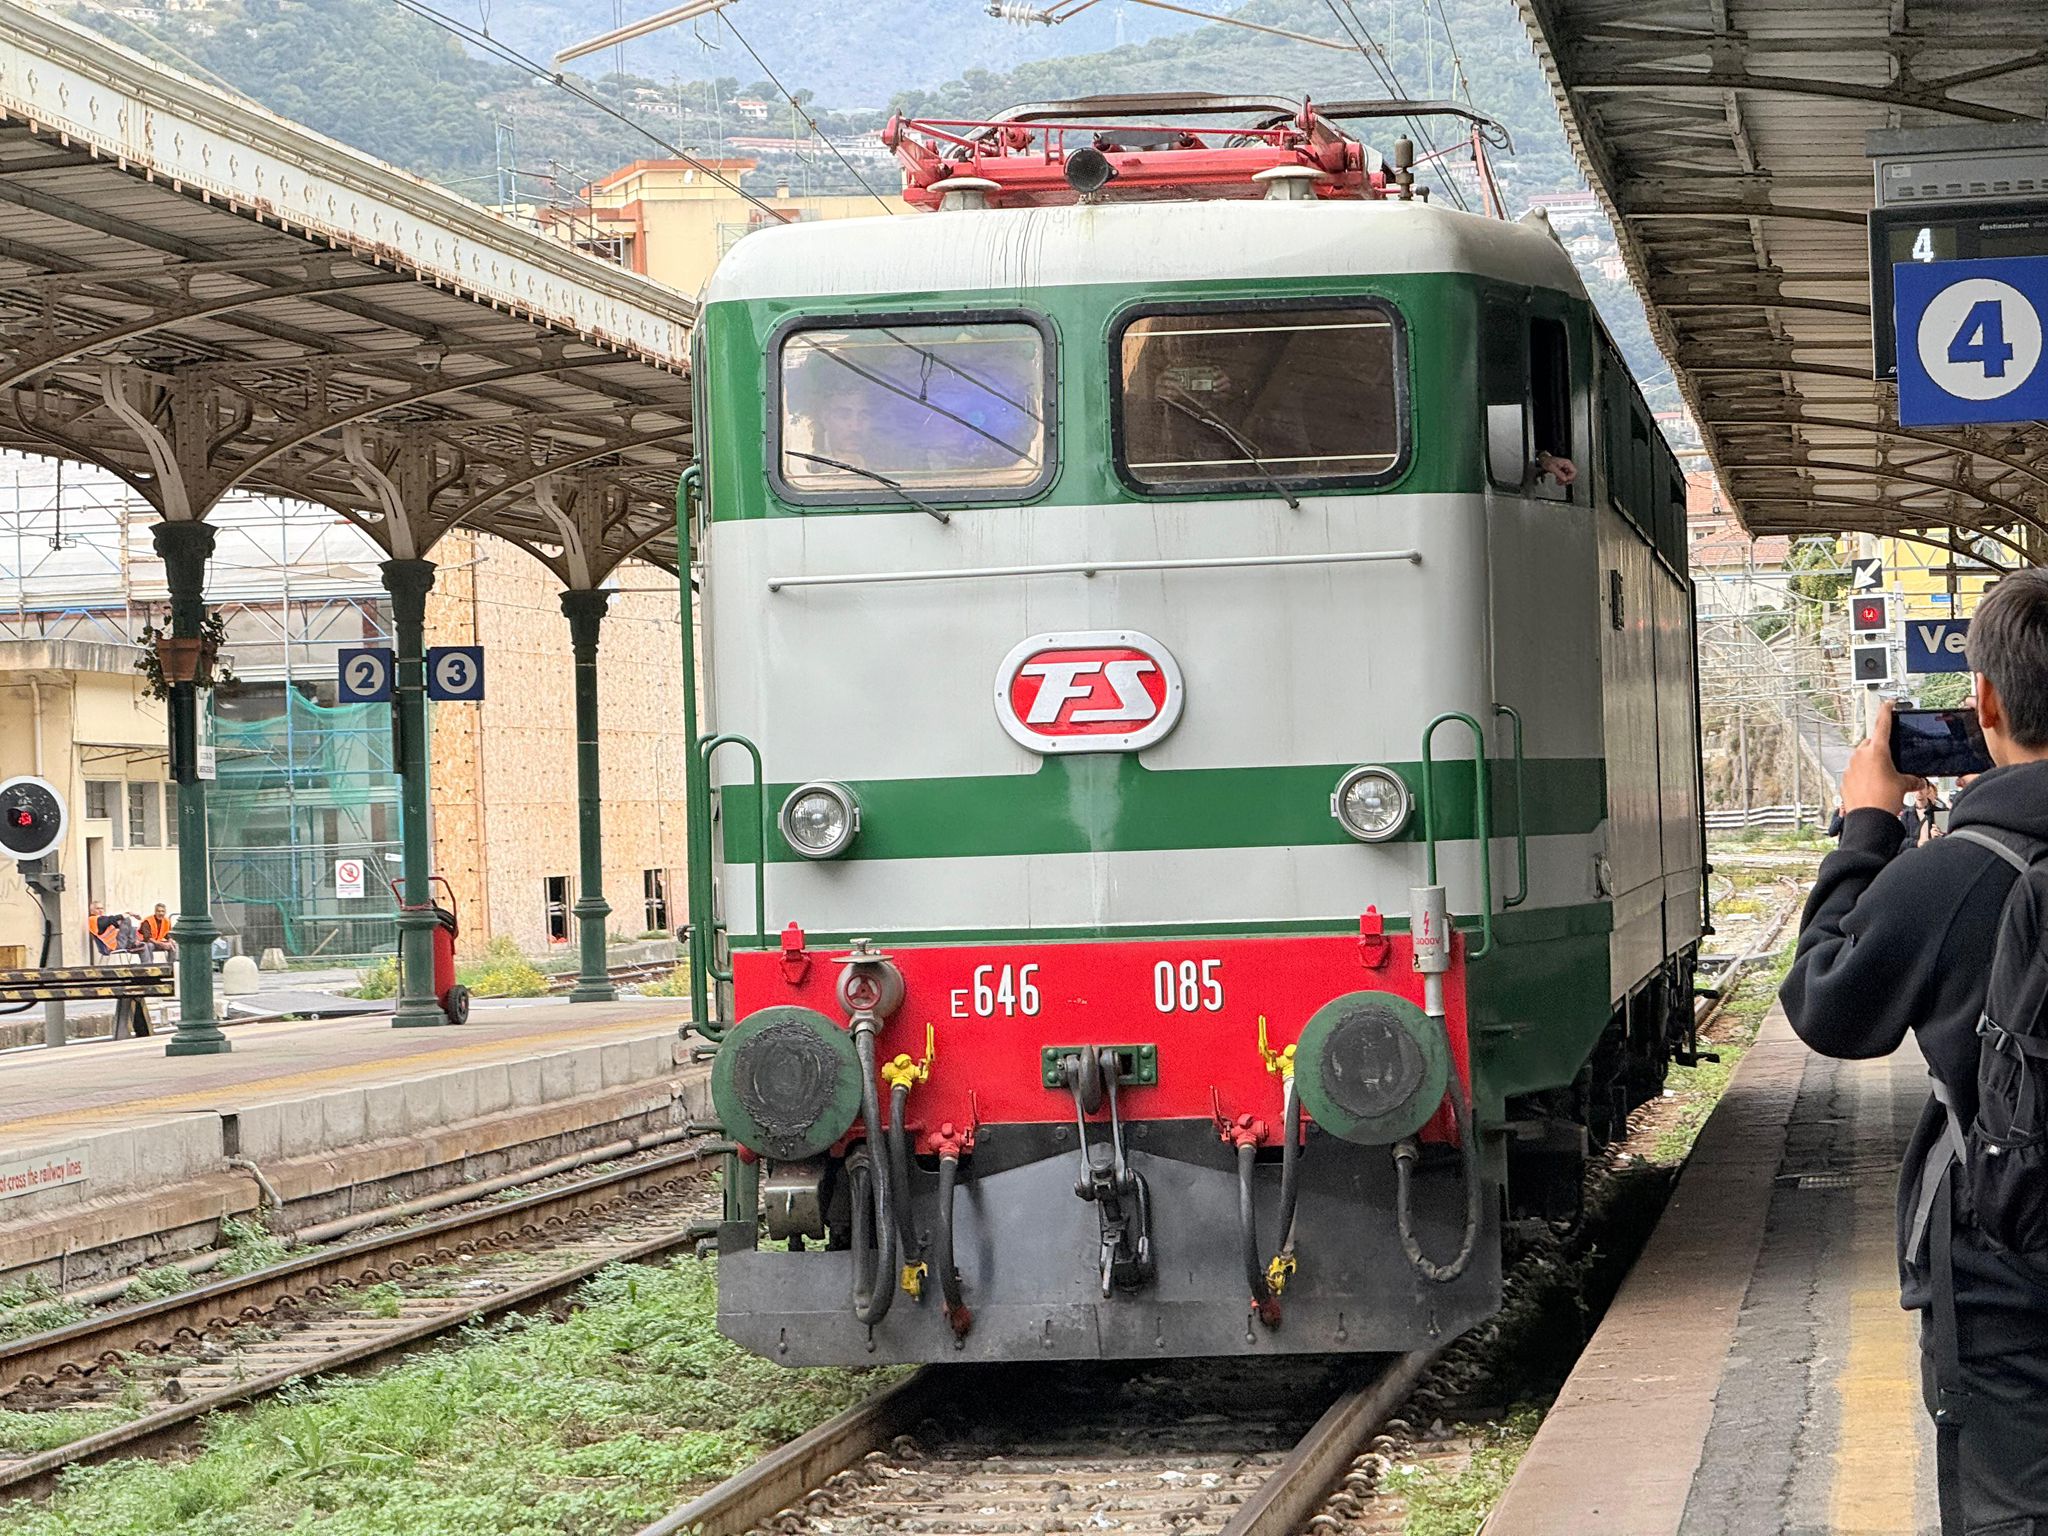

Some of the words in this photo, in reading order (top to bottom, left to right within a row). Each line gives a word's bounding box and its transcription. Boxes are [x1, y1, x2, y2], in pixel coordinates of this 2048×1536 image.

[1912, 228, 1934, 263] 4
[1947, 300, 2013, 377] 4
[355, 661, 375, 688] 2
[446, 659, 468, 687] 3
[1021, 660, 1157, 724] FS
[1154, 959, 1223, 1013] 085
[7, 1173, 26, 1192] cross
[27, 1165, 38, 1186] the
[40, 1160, 65, 1184] railway
[66, 1156, 81, 1177] lines
